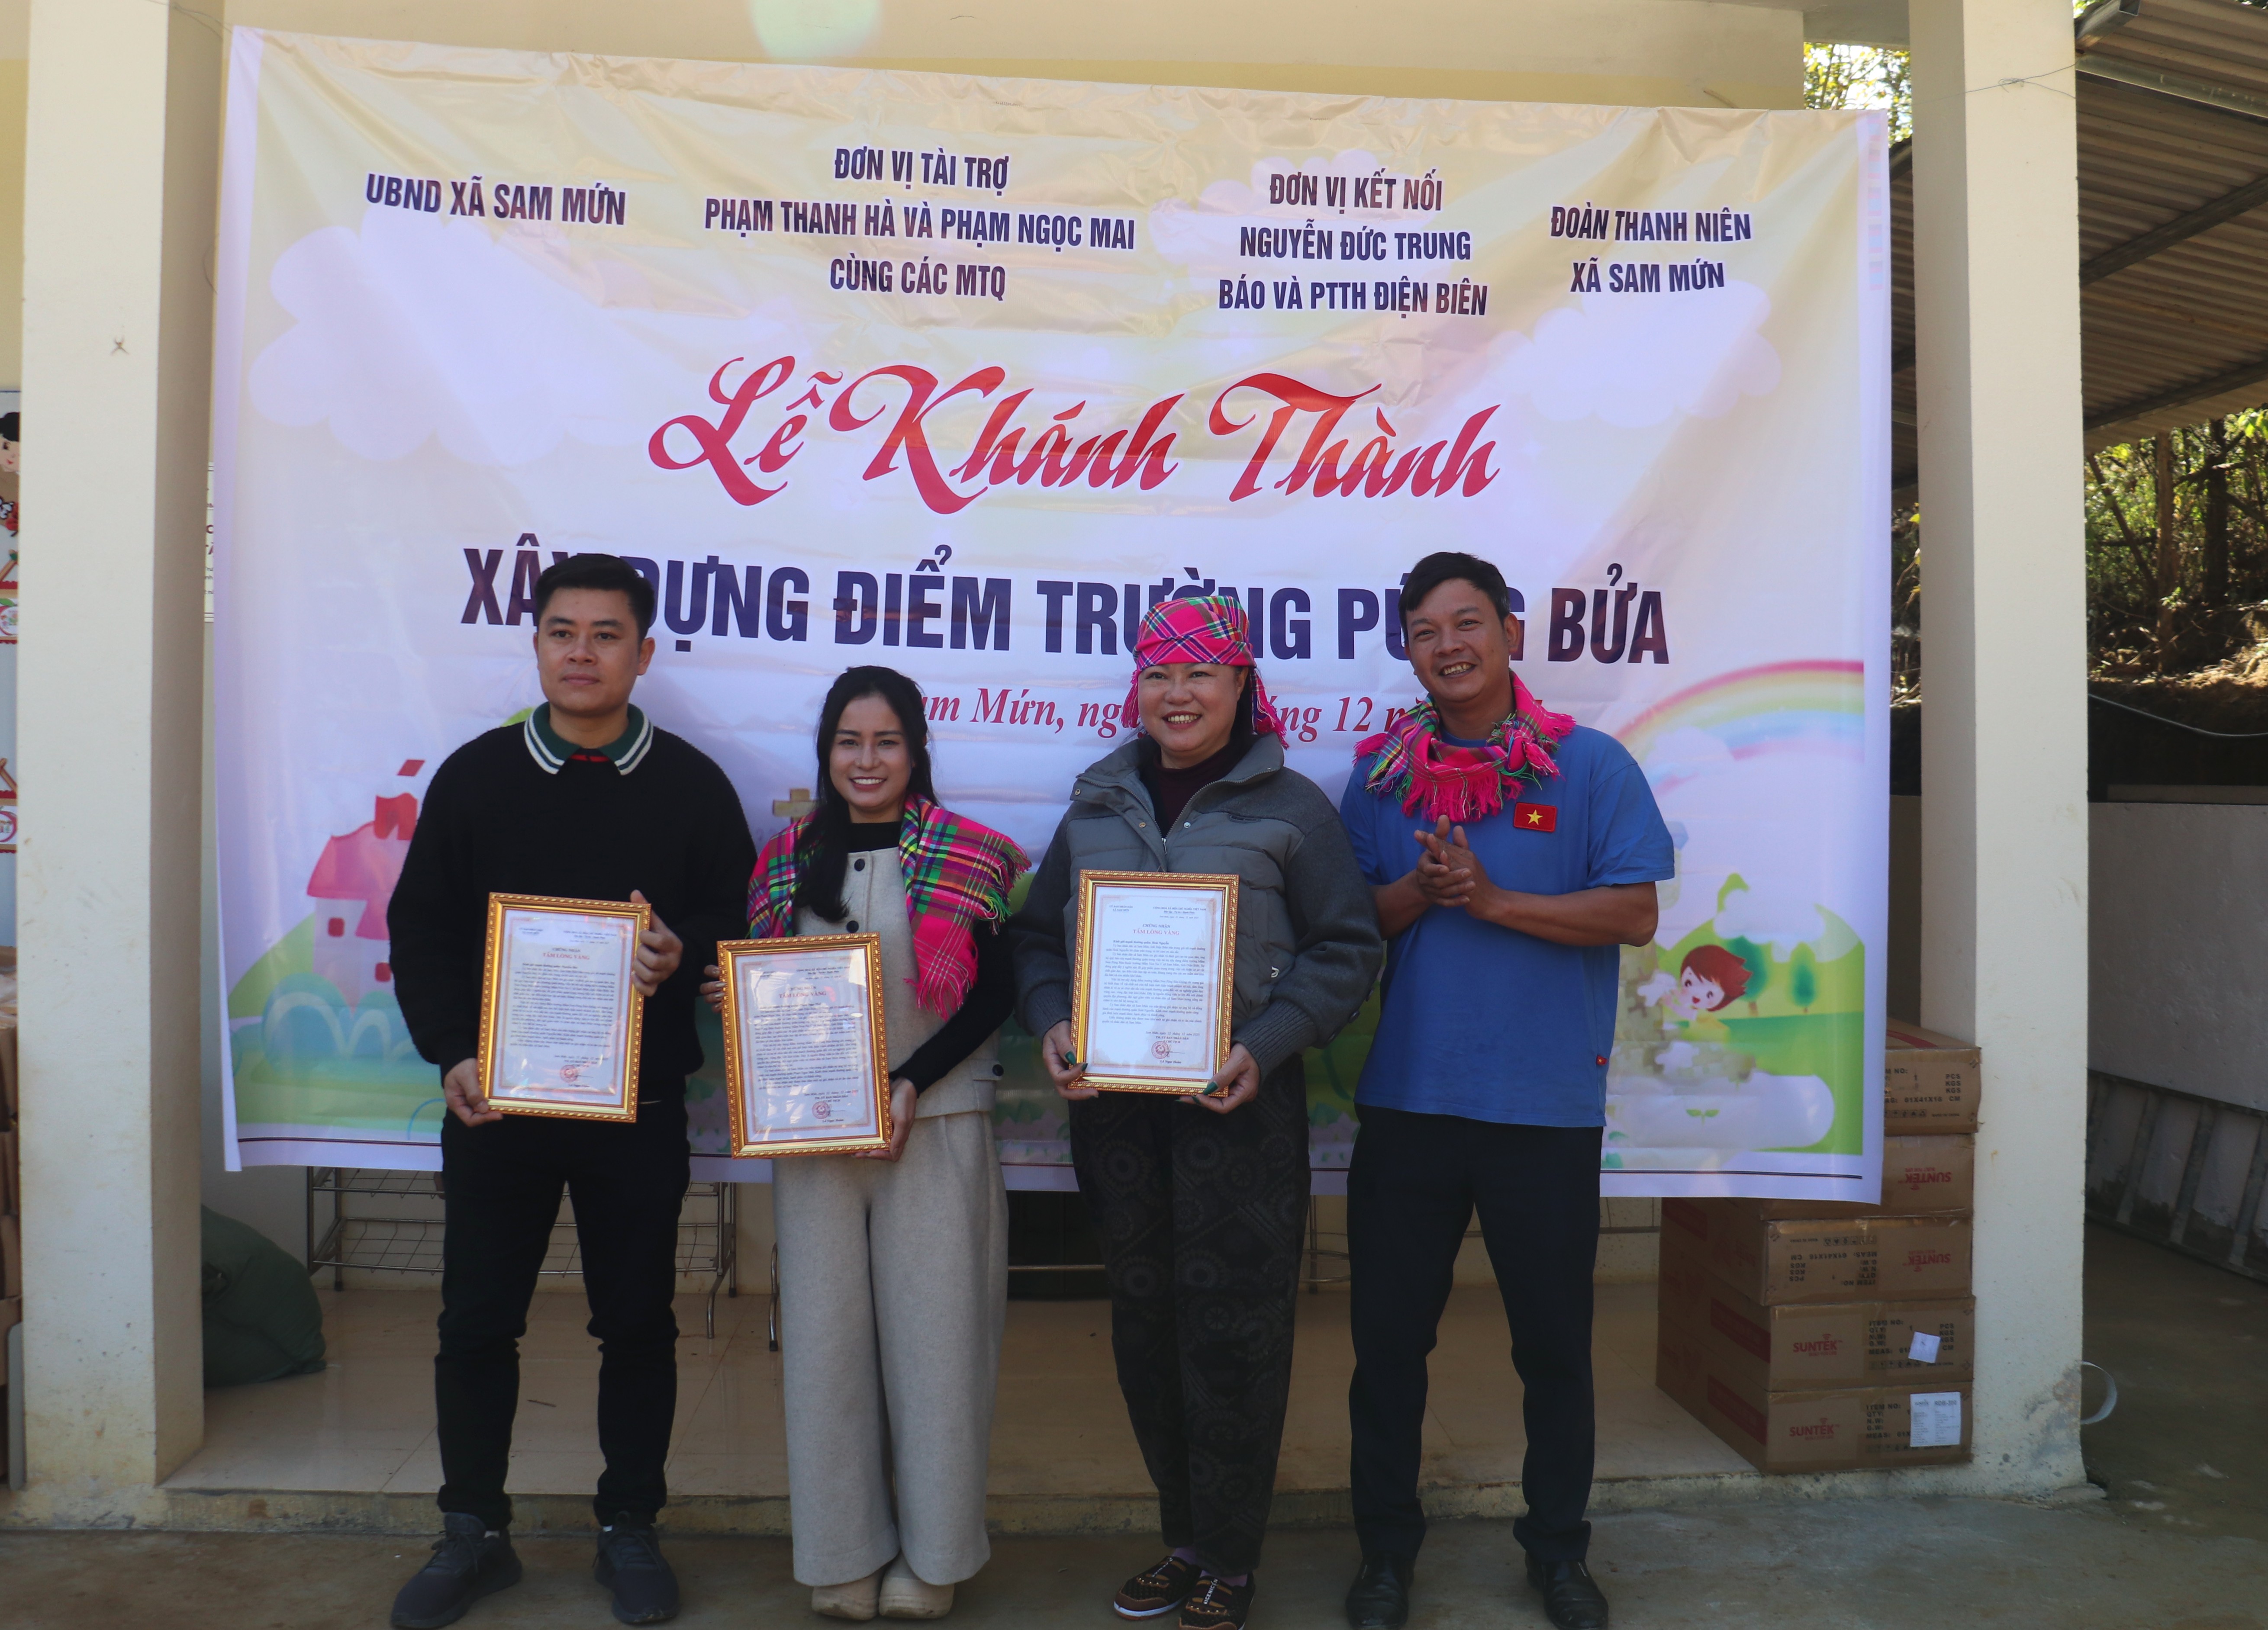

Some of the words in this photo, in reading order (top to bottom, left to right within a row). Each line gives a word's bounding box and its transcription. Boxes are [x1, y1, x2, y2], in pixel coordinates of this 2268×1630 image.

[834, 146, 883, 180] ĐƠN
[892, 150, 912, 190] VỊ
[921, 148, 956, 186] TÀI
[964, 156, 1009, 196] TRỢ
[1270, 171, 1318, 206] ĐƠN
[1325, 177, 1346, 214] VỊ
[1354, 168, 1396, 209] KẾT
[1403, 169, 1442, 211] NỐI
[366, 174, 441, 212] UBND
[450, 176, 485, 217] XÃ
[494, 184, 552, 221] SAM
[562, 183, 625, 225] MỨN
[1550, 202, 1609, 240] ĐOÀN
[1615, 211, 1687, 241] THANH
[1695, 207, 1751, 241] NIÊN
[705, 198, 773, 238] PHẠM
[781, 200, 856, 235] THANH
[865, 199, 895, 237] HÀ
[904, 201, 932, 238] VÀ
[941, 209, 1010, 248] PHẠM
[1018, 214, 1082, 252] NGỌC
[1090, 218, 1134, 250] MAI
[1240, 219, 1332, 260] NGUYỄN
[1340, 226, 1386, 260] ĐỨC
[1395, 231, 1471, 260] TRUNG
[830, 253, 892, 293] CÙNG
[901, 256, 947, 296] CÁC
[956, 264, 1005, 302] MTQ
[1219, 274, 1265, 309] BÁO
[1273, 276, 1303, 309] VÀ
[1311, 282, 1366, 309] PTTH
[1374, 276, 1428, 319] ĐIỆN
[1436, 278, 1487, 316] BIÊN
[1570, 257, 1601, 292] XÃ
[1609, 263, 1660, 293] SAM
[1669, 259, 1724, 292] MỨN
[648, 355, 843, 506] Lễ
[829, 365, 1185, 514] Khánh
[1209, 373, 1501, 502] Thành
[833, 544, 1012, 651] ĐIỂM
[1547, 563, 1669, 665] BỬA
[969, 688, 1064, 734] Mứn,
[1332, 696, 1373, 732] 12
[1905, 1172, 1952, 1183] SUNTEK
[1908, 1254, 1951, 1266] SUNTEK
[1793, 1340, 1837, 1353] SUNTEK
[1789, 1424, 1834, 1437] SUNTEK
